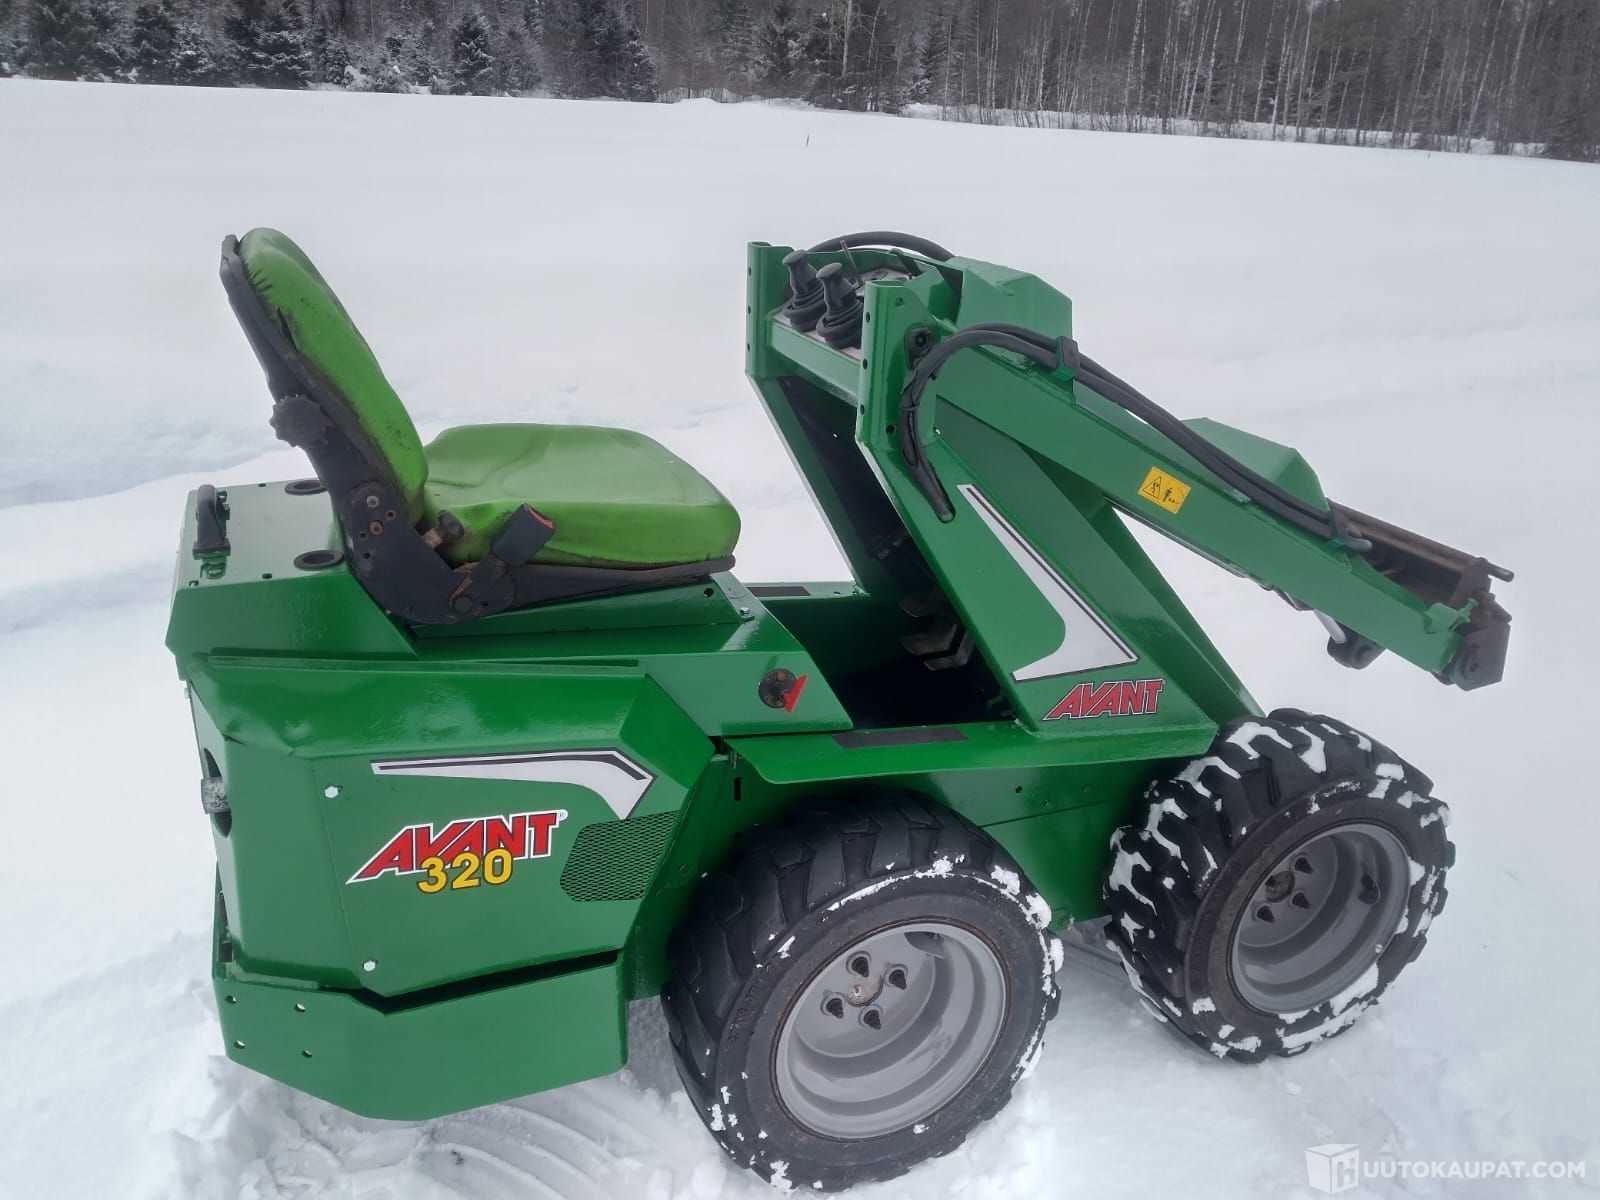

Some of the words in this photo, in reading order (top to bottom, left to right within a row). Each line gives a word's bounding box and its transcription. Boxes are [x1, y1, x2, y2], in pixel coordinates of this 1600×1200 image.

[1042, 678, 1164, 721] AVANT
[345, 810, 562, 884] AVANT
[417, 848, 513, 893] 320
